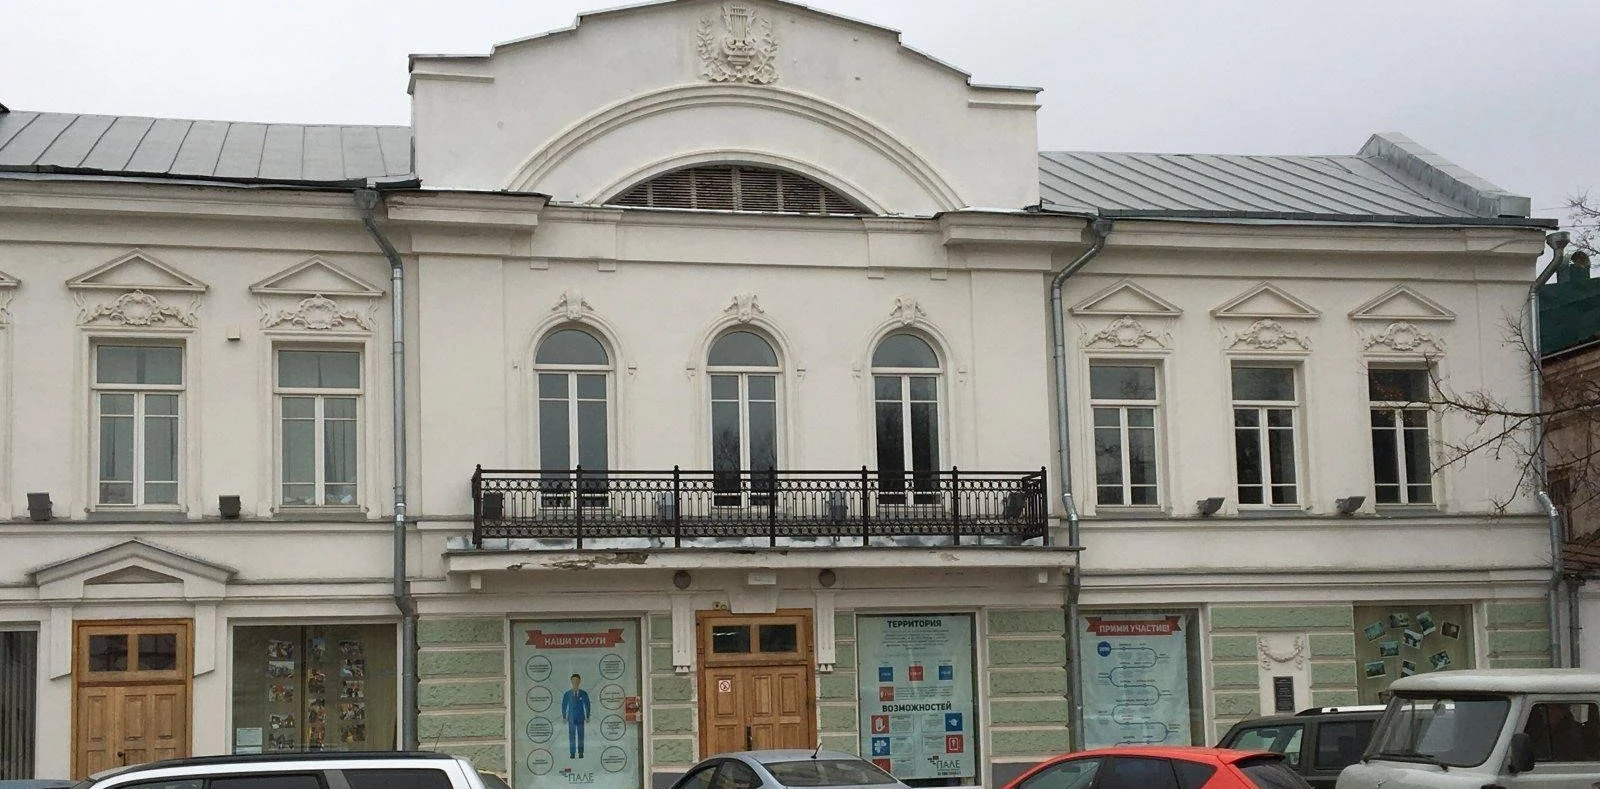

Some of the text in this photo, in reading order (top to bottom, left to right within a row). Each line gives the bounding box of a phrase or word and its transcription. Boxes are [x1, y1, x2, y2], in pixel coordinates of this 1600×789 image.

[887, 620, 942, 628] ТЕРРИТОРИЯ
[1100, 624, 1169, 633] ПРИМИ УЧАСТИЕ!
[544, 636, 606, 646] НАШИ УСЛУГИ
[882, 701, 952, 712] ВОЗМОЖНОСТЕЙ
